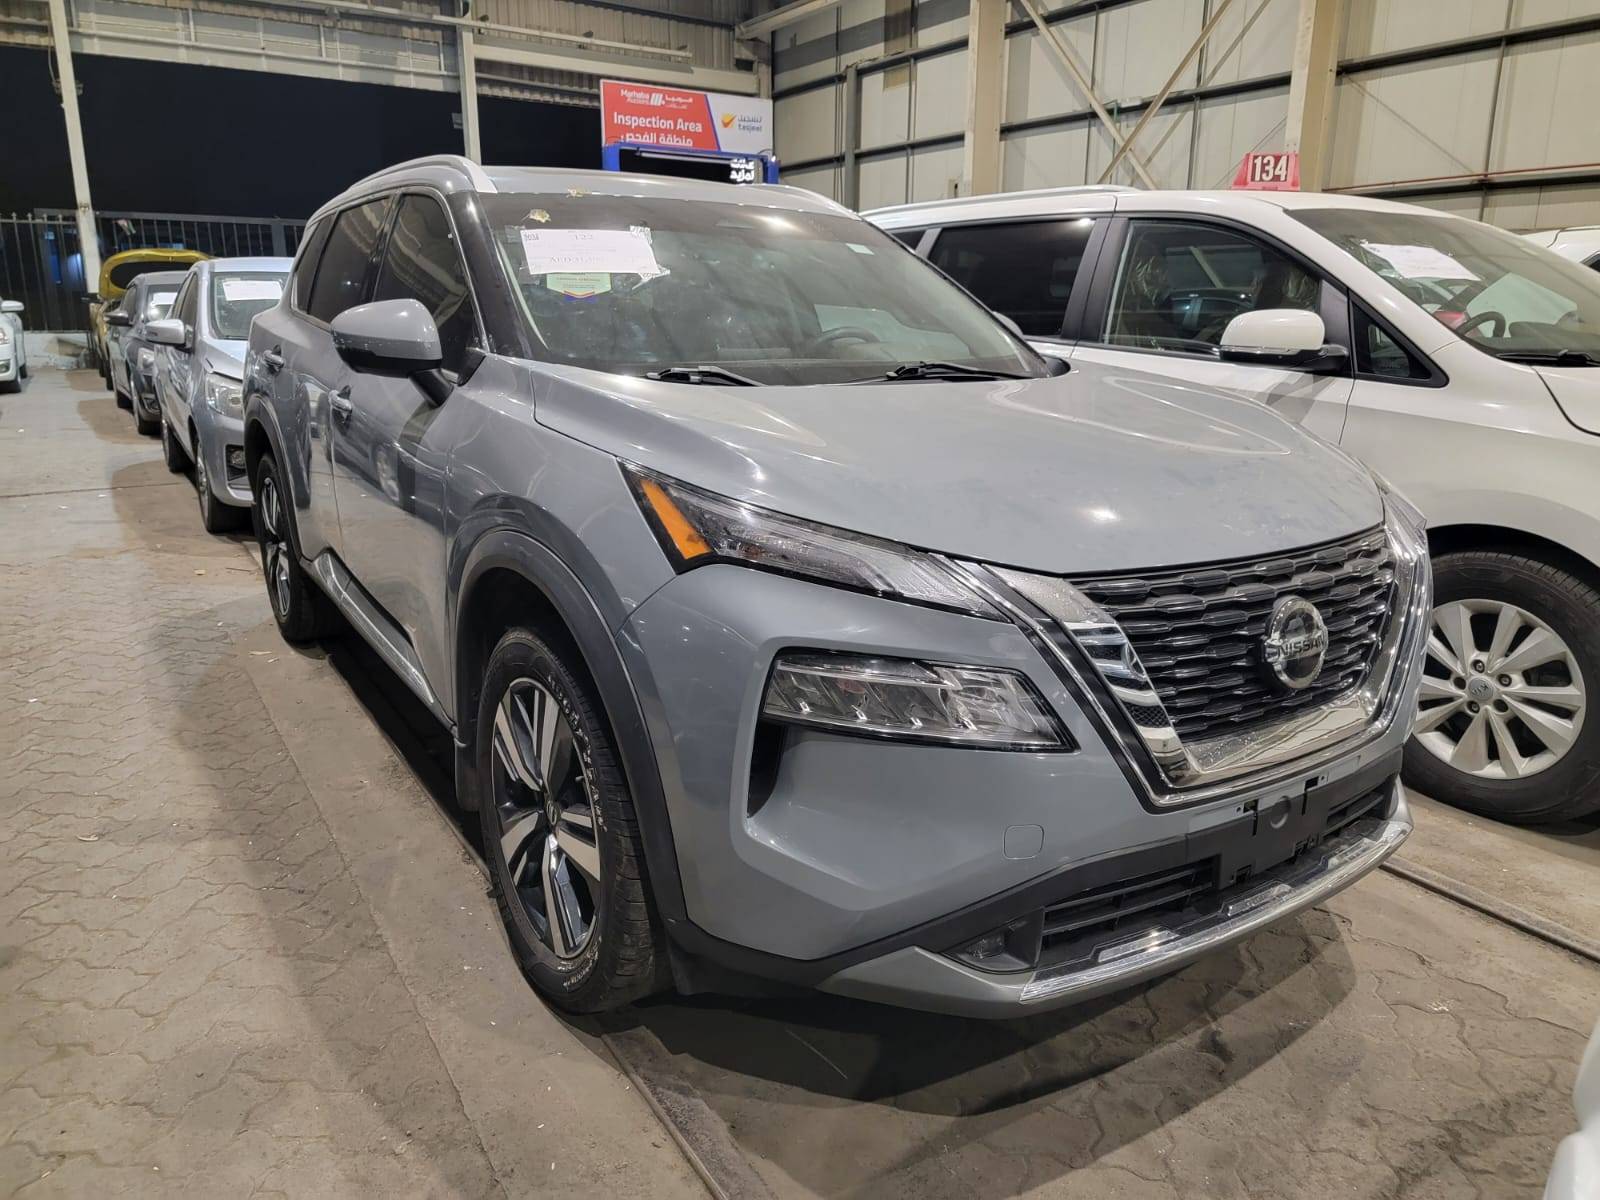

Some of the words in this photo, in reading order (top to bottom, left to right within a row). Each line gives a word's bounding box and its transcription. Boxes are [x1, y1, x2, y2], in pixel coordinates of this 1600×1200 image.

[613, 112, 674, 130] Inspection
[676, 118, 703, 133] Area
[1254, 153, 1289, 181] 134
